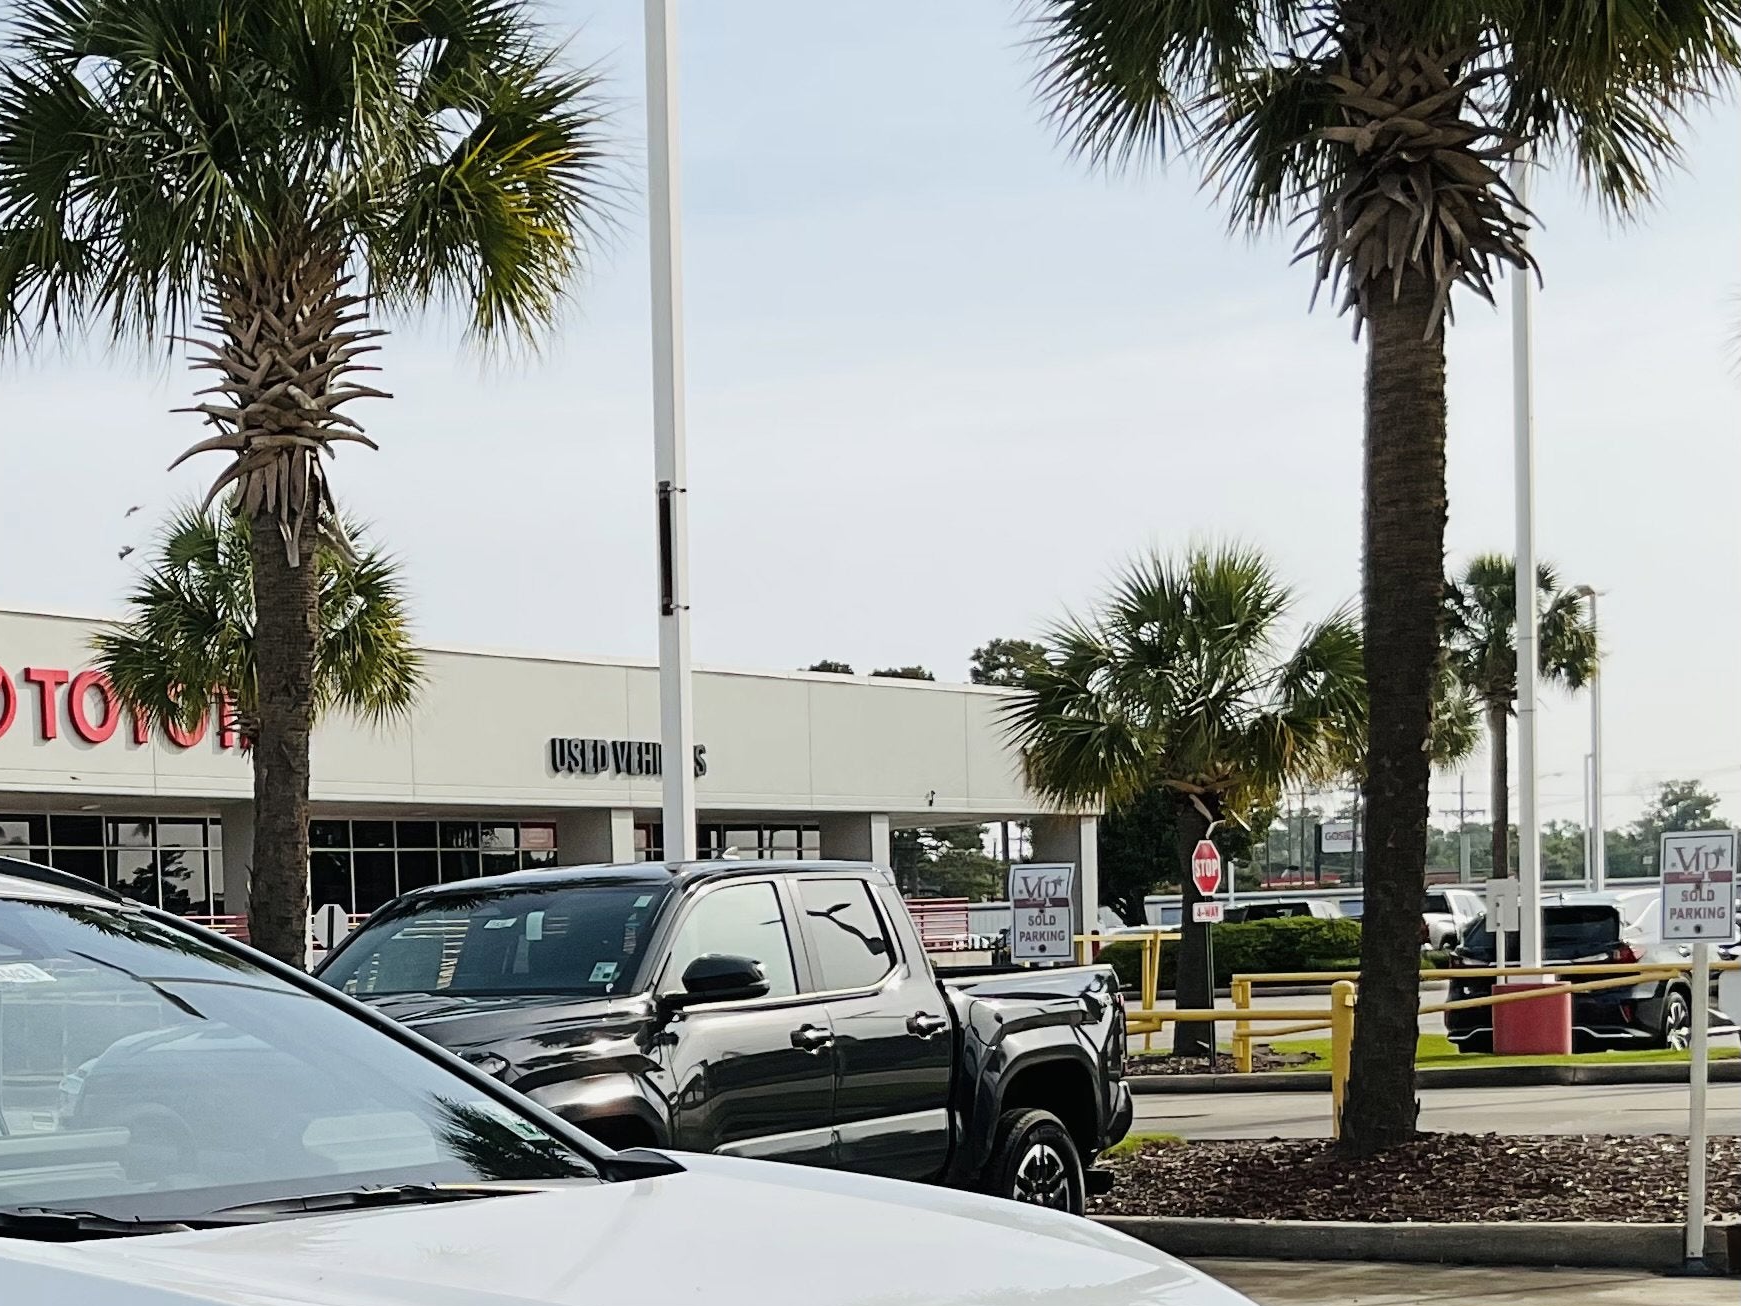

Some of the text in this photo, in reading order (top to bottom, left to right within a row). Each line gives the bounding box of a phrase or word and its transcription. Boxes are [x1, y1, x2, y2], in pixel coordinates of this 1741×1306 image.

[551, 738, 707, 777] USED VEHIS
[1194, 858, 1218, 877] STOP
[1681, 889, 1715, 902] SOLD
[1669, 906, 1726, 920] PARKING
[1028, 914, 1057, 927] SOLD
[1020, 930, 1066, 942] PARKING
